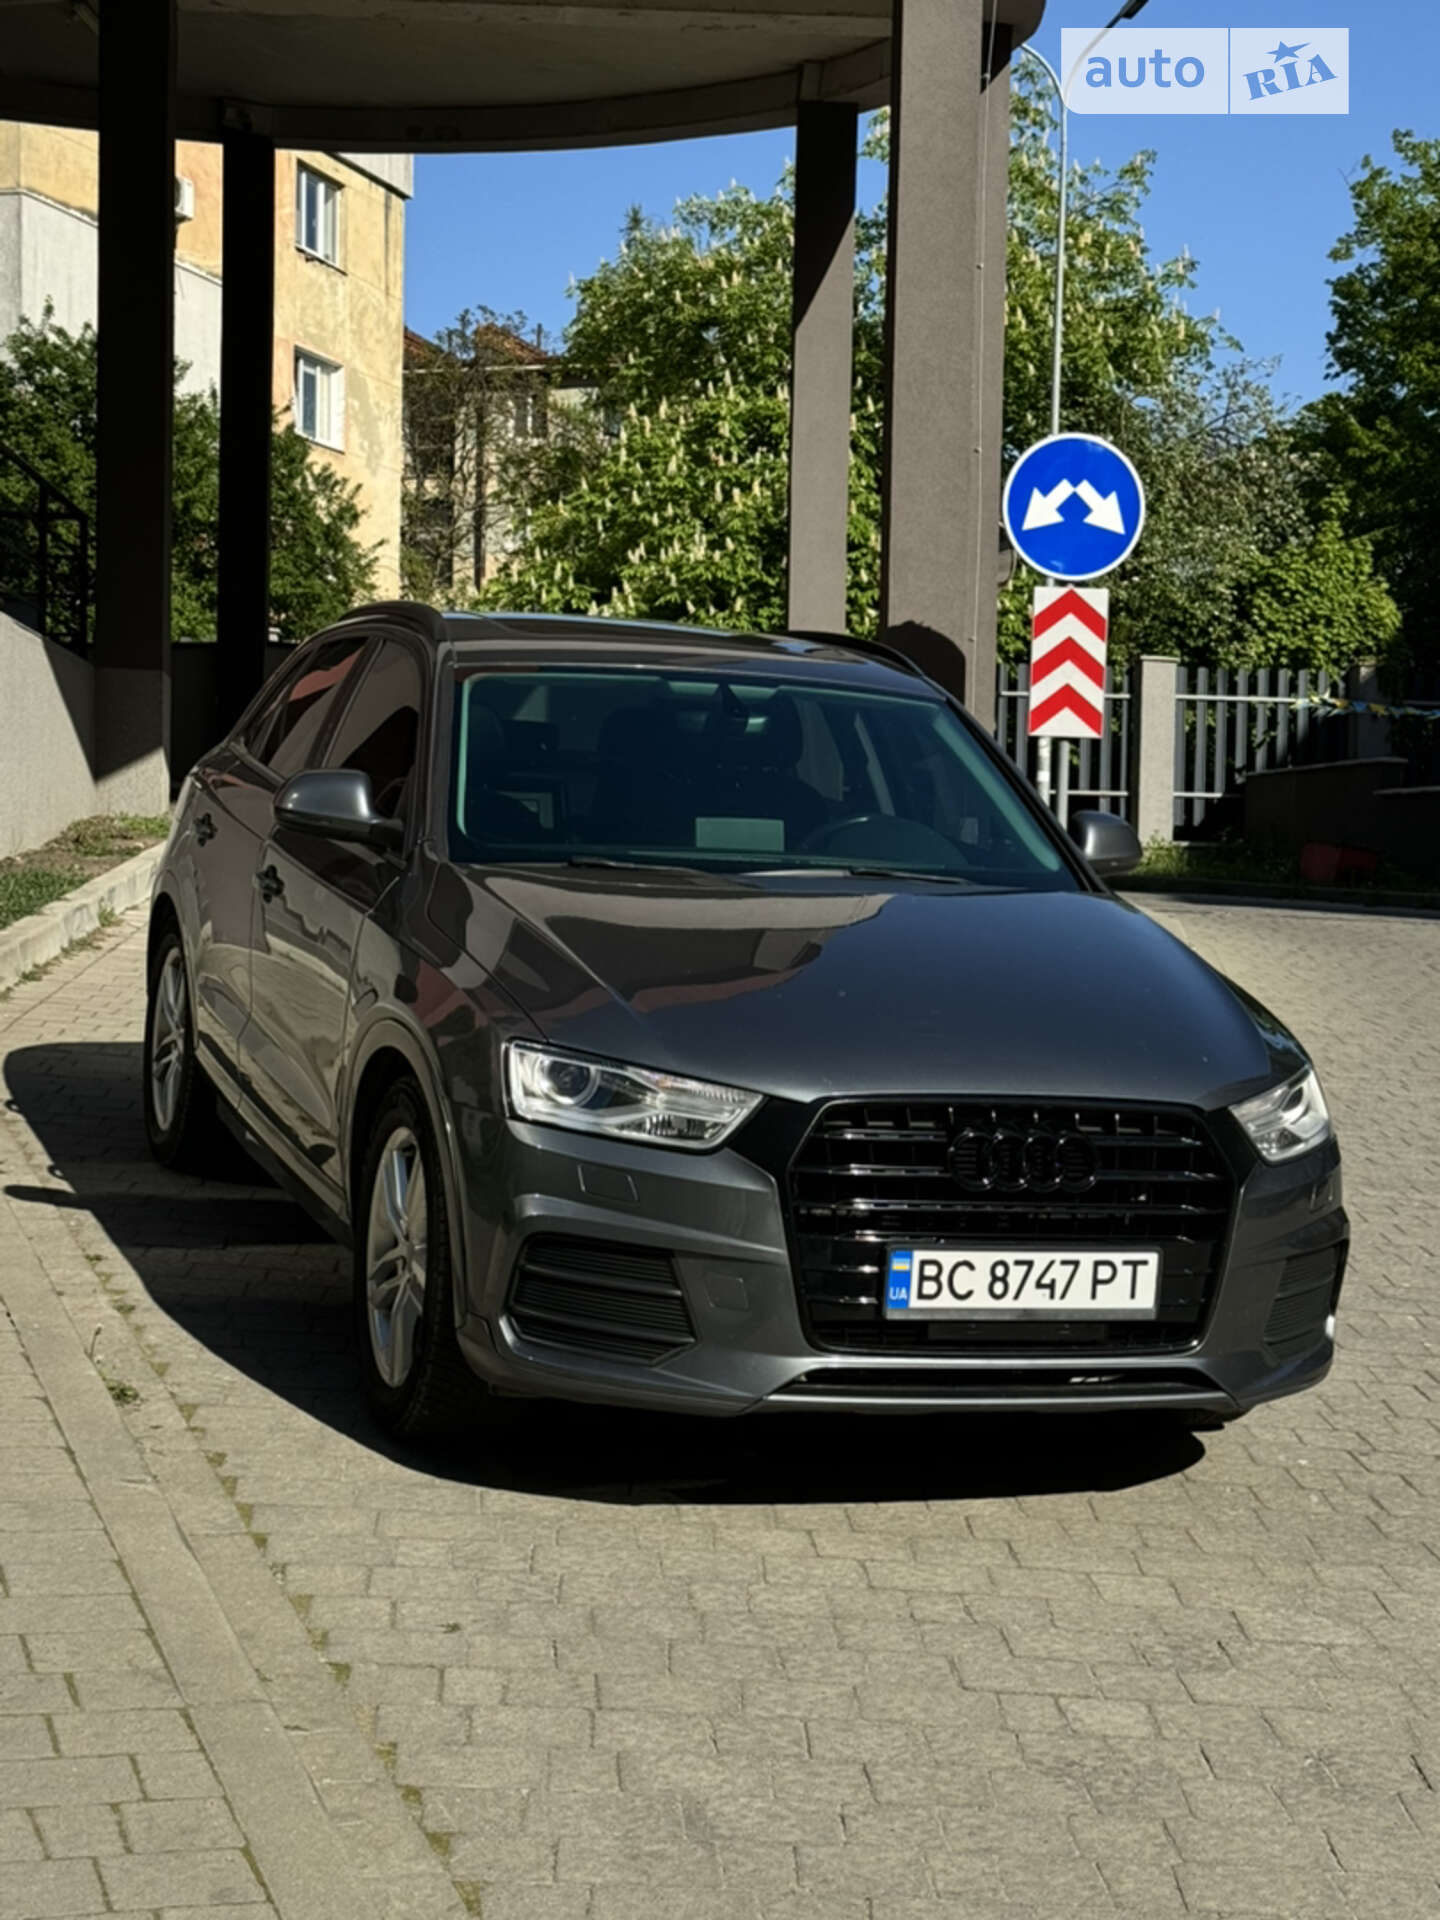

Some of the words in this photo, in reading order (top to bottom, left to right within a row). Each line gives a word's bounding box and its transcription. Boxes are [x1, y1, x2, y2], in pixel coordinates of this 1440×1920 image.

[889, 1287, 908, 1300] UA
[916, 1259, 976, 1300] BC
[988, 1259, 1081, 1301] 8747
[1091, 1259, 1149, 1300] PT
